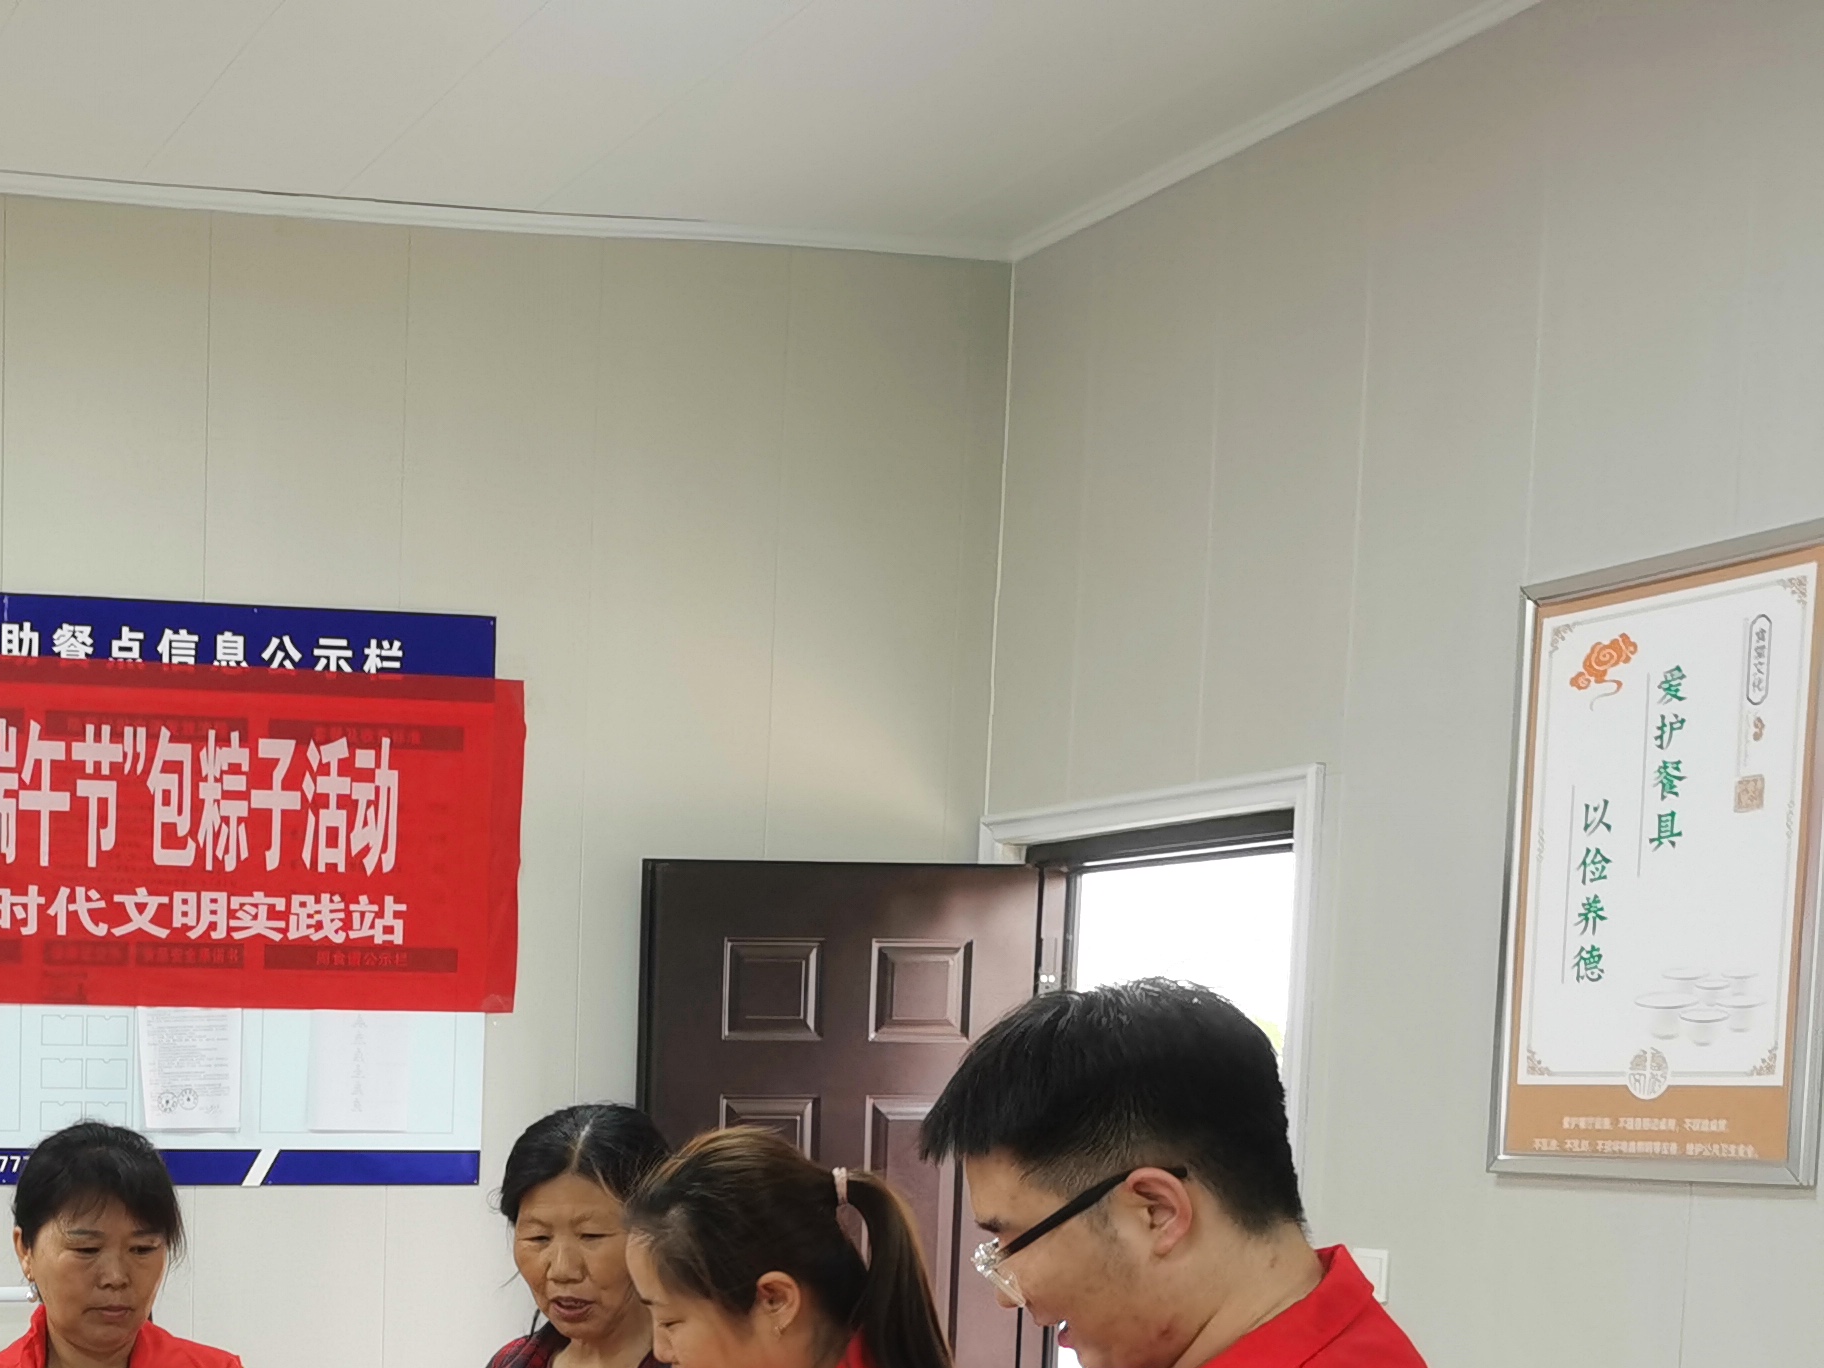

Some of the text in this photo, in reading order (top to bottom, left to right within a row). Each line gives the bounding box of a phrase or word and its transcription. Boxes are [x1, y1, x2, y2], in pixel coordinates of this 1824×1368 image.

[1649, 664, 1688, 851] 爱护餐具
[1572, 799, 1614, 984] 以俭养德
